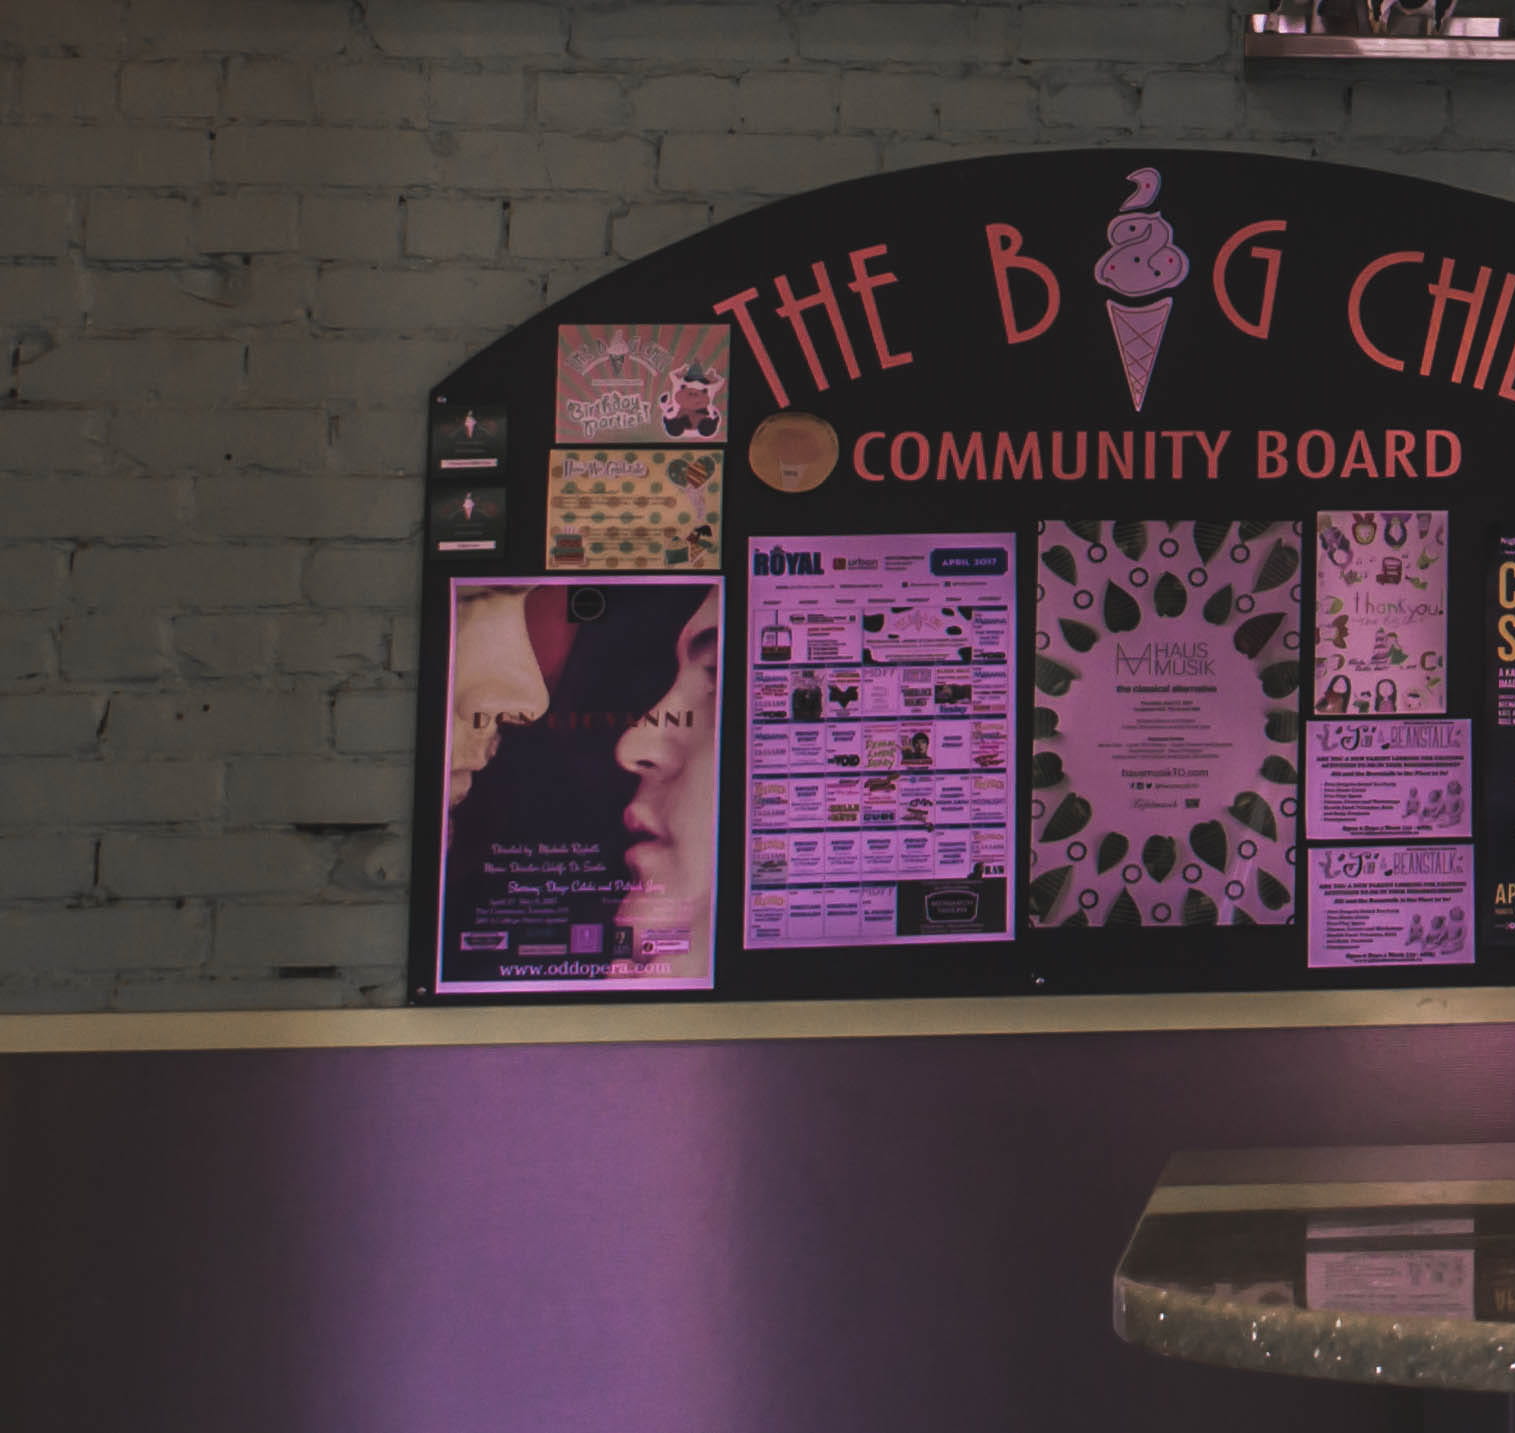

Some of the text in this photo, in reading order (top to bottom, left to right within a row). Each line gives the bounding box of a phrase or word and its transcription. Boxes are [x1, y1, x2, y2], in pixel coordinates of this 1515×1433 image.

[713, 244, 914, 409] THE
[853, 428, 1464, 482] COMMUNITY BOARD
[753, 546, 825, 576] ROYAL
[1154, 642, 1209, 658] HAUS
[1154, 658, 1216, 675] MUSIK
[499, 960, 673, 979] www.oddopera.com
